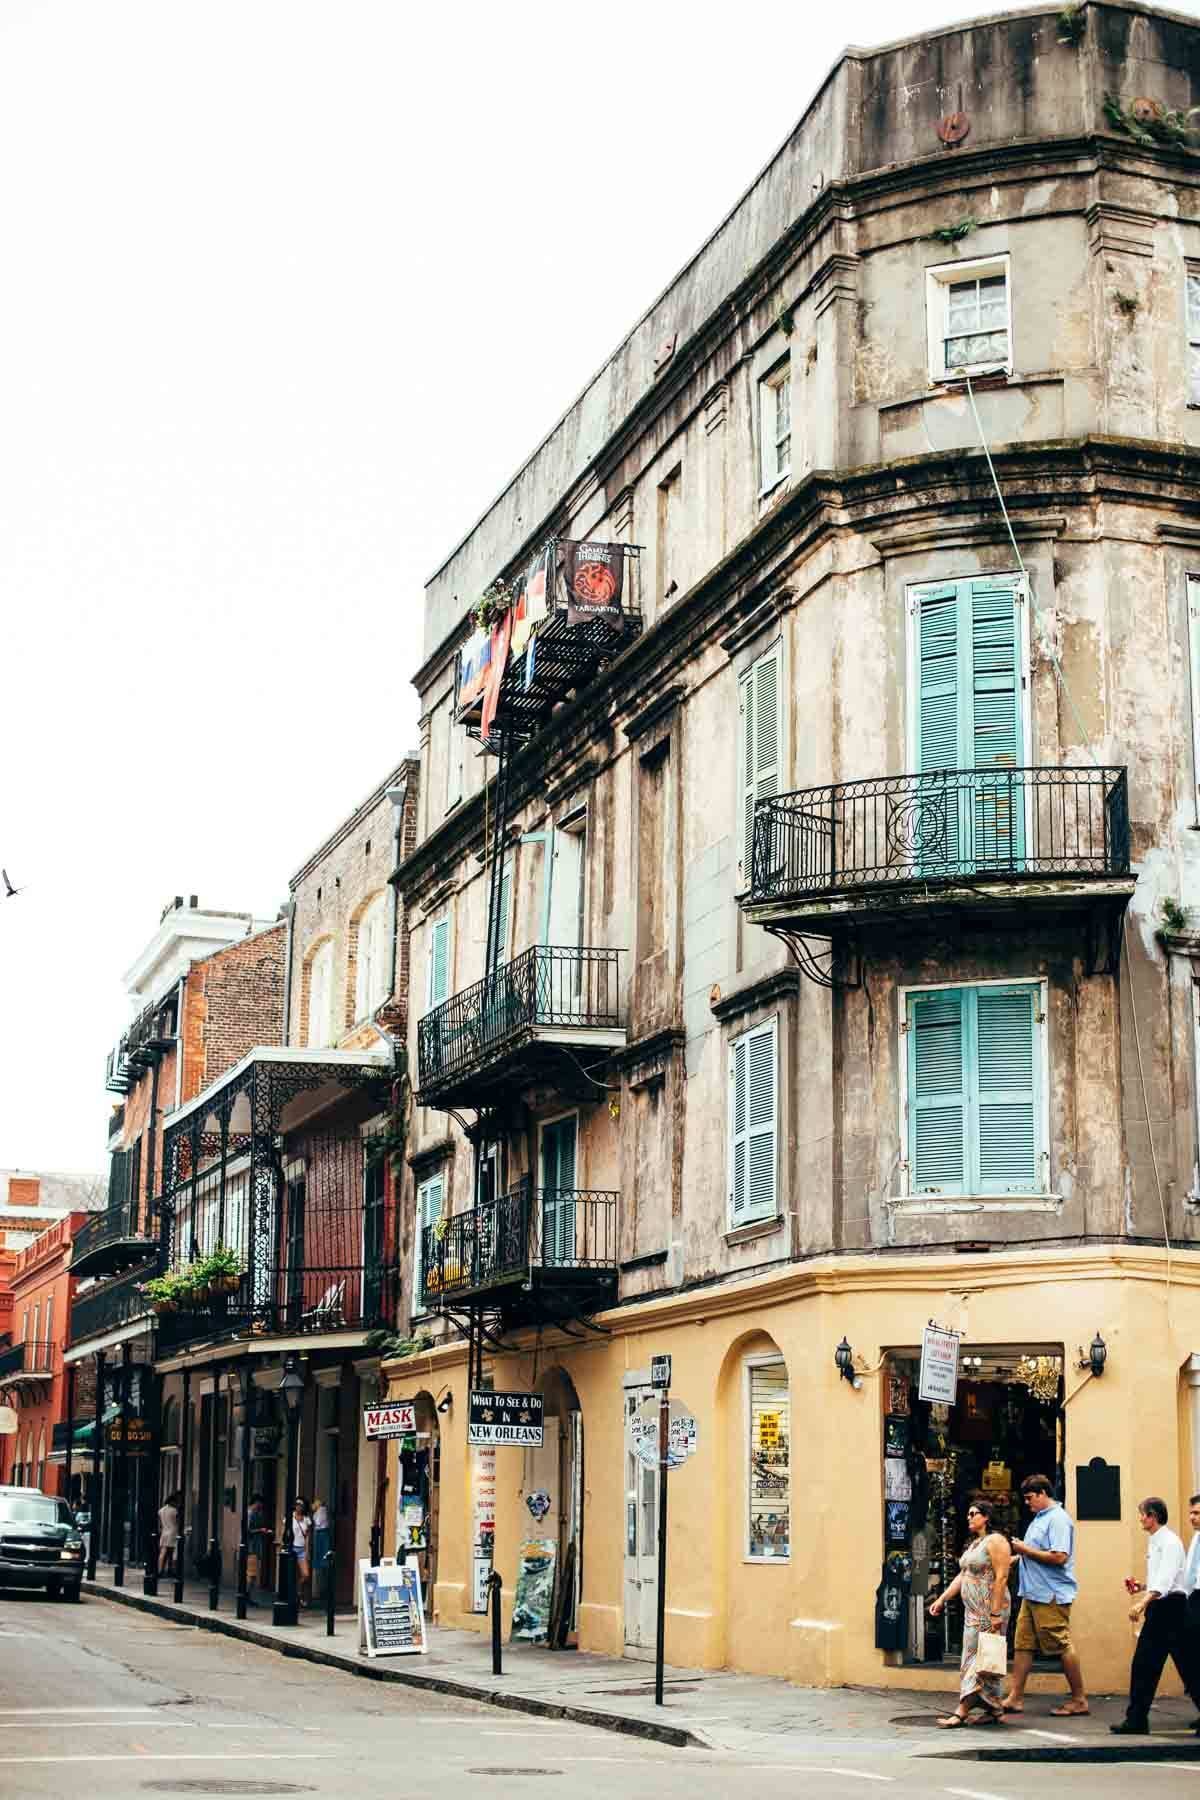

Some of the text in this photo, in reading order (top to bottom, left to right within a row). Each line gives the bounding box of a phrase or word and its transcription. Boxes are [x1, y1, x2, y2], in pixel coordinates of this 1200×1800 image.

[521, 1397, 528, 1408] &
[367, 1408, 412, 1426] MASK
[470, 1425, 542, 1440] NEW ORLEANS
